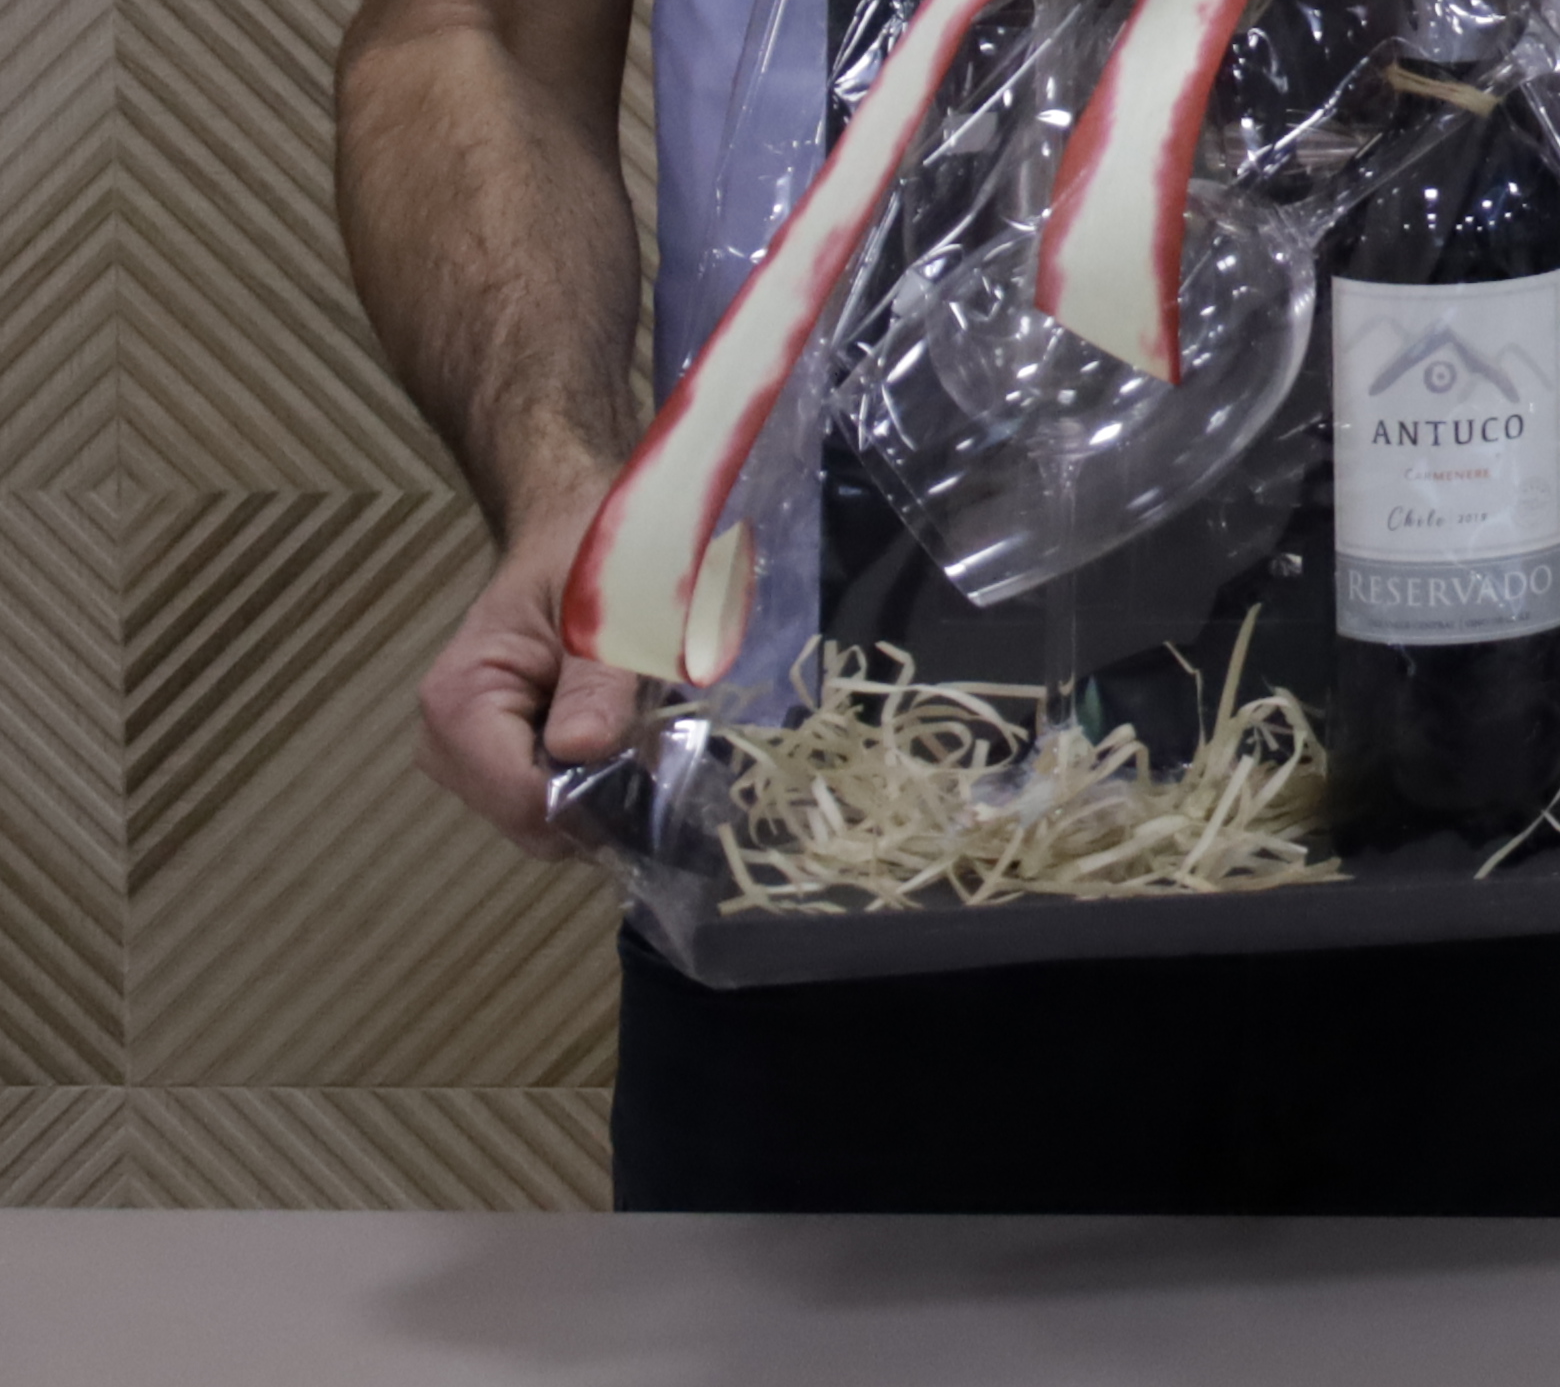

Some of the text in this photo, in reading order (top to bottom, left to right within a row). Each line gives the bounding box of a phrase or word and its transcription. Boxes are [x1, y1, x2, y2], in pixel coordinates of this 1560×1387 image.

[1371, 413, 1525, 447] ANTUCO
[1387, 505, 1445, 532] Chile
[1348, 564, 1552, 607] RESERVADO
